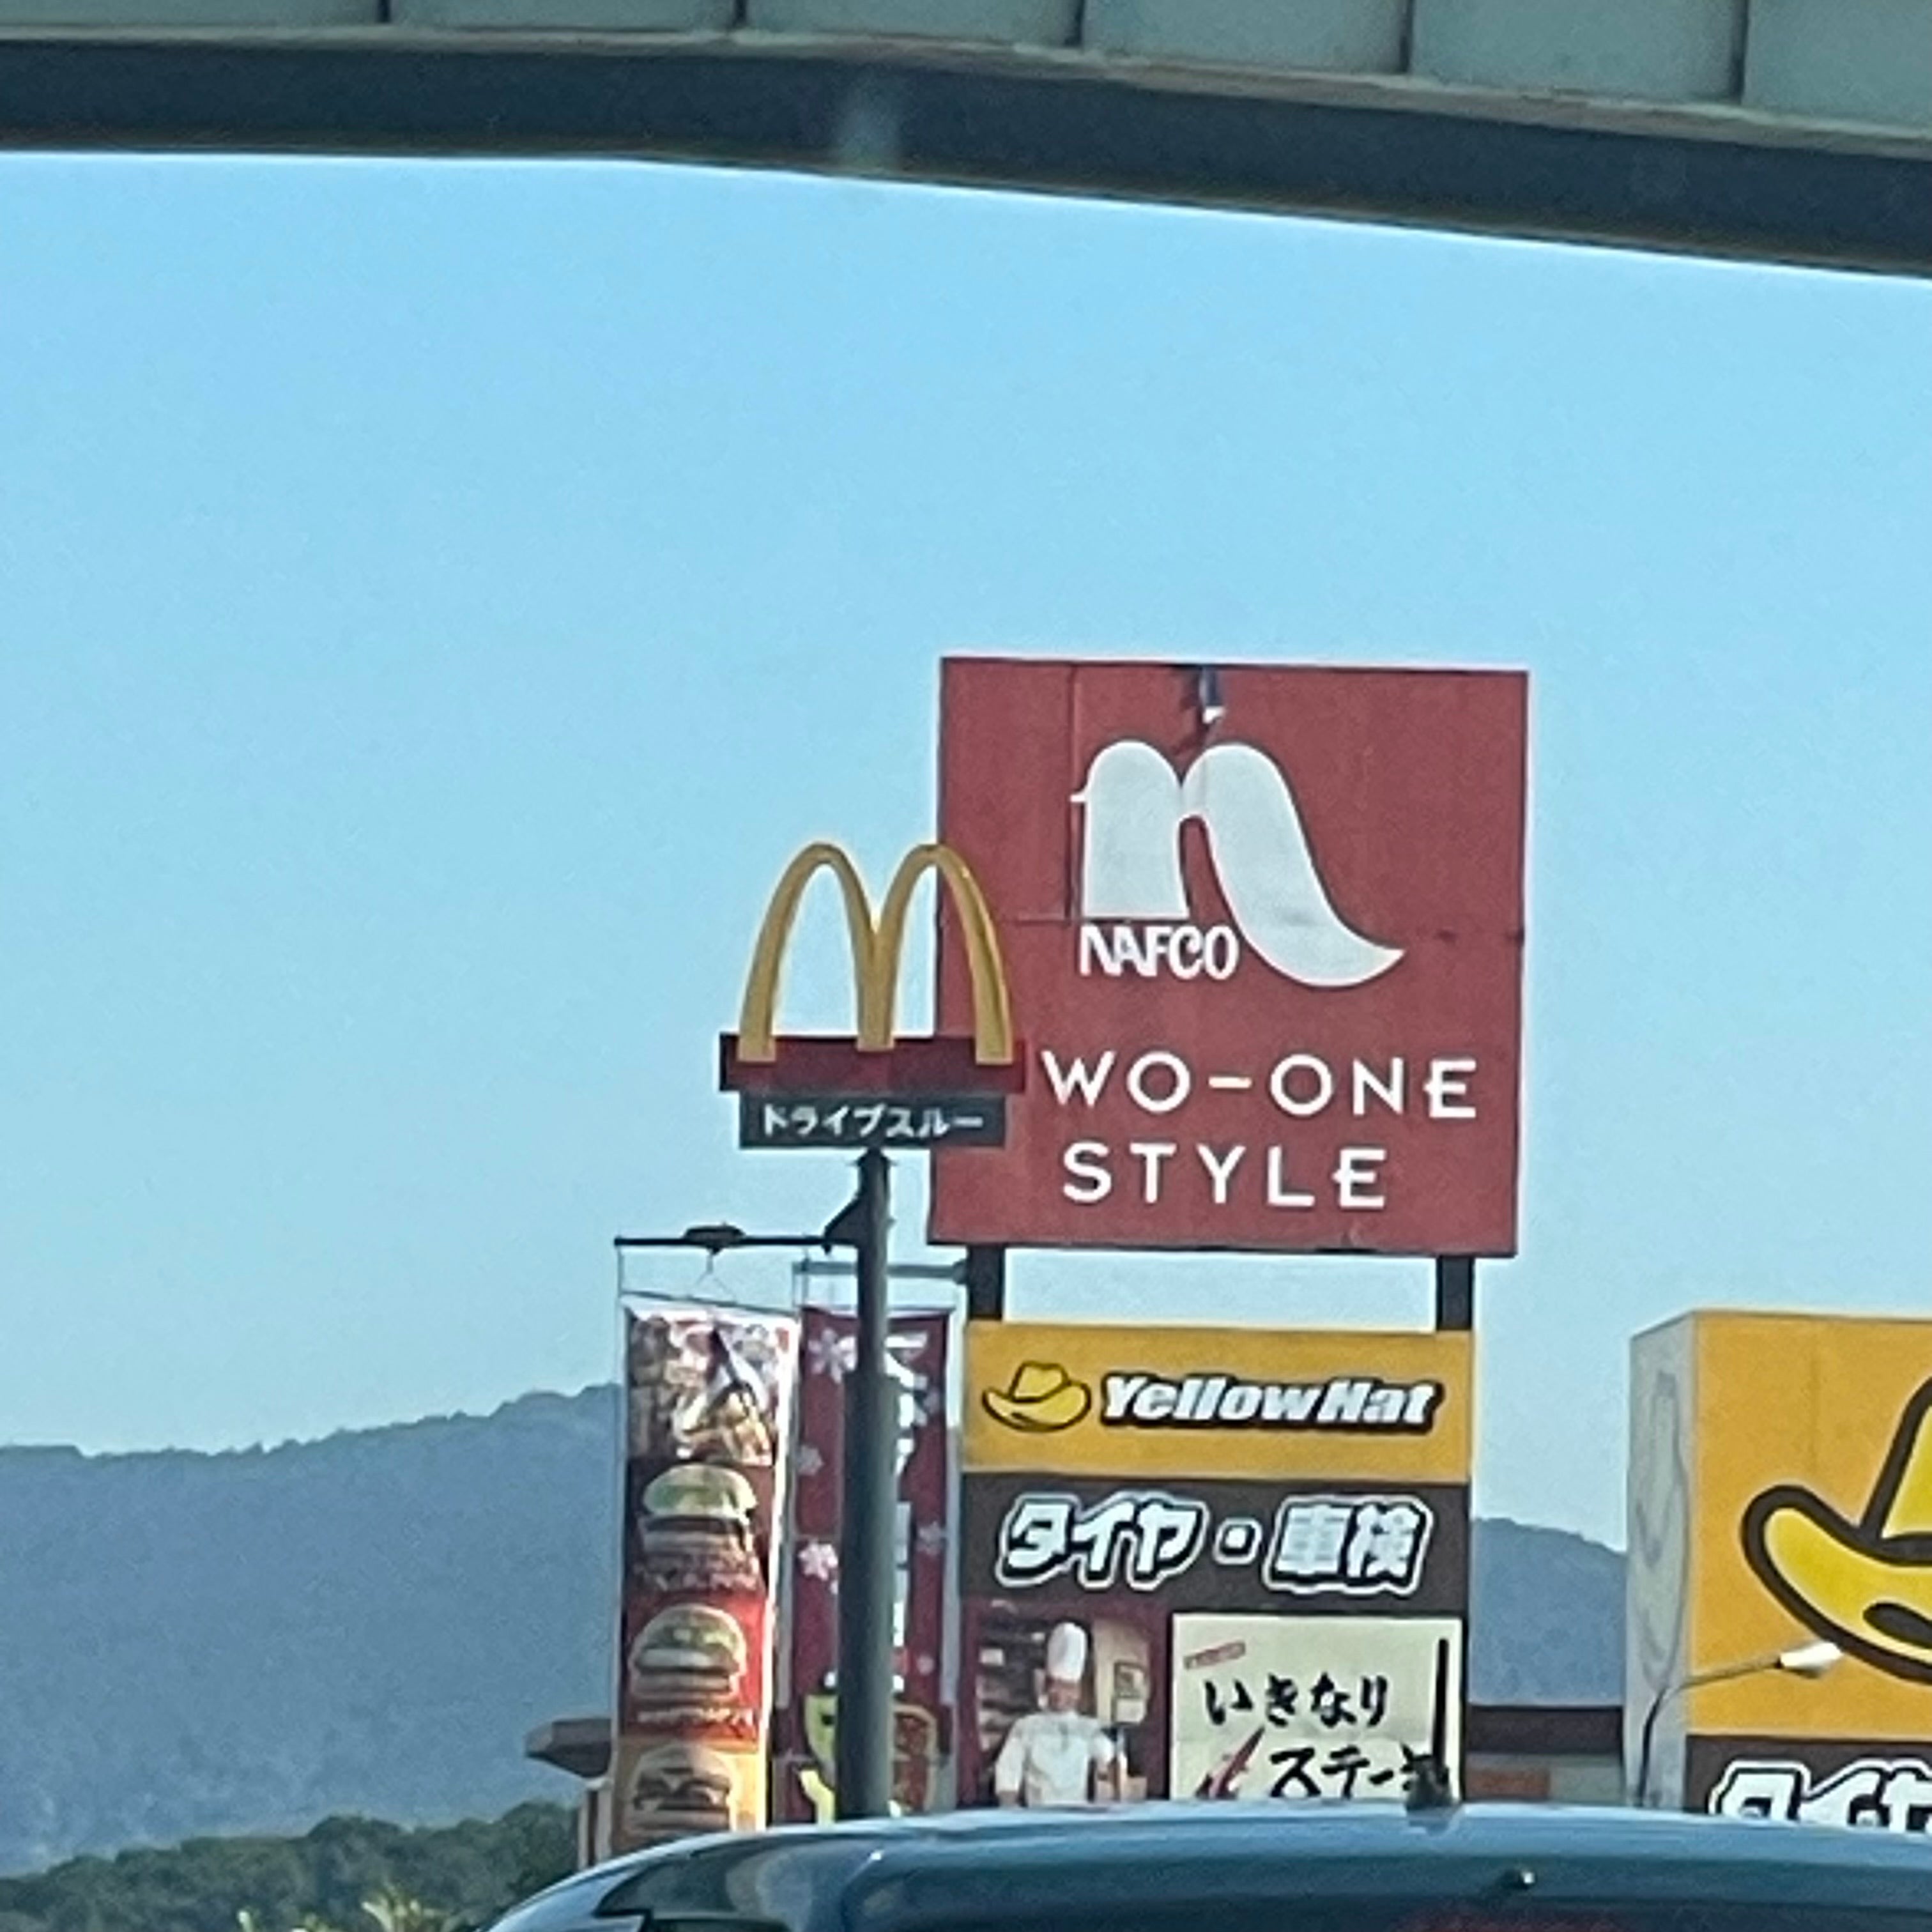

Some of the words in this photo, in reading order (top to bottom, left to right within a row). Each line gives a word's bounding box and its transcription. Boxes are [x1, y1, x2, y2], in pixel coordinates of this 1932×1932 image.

[1079, 924, 1239, 980] NAFCO
[1041, 1050, 1476, 1119] WO-ONE
[1062, 1142, 1388, 1209] STYLE
[1203, 1670, 1389, 1727] いきなり
